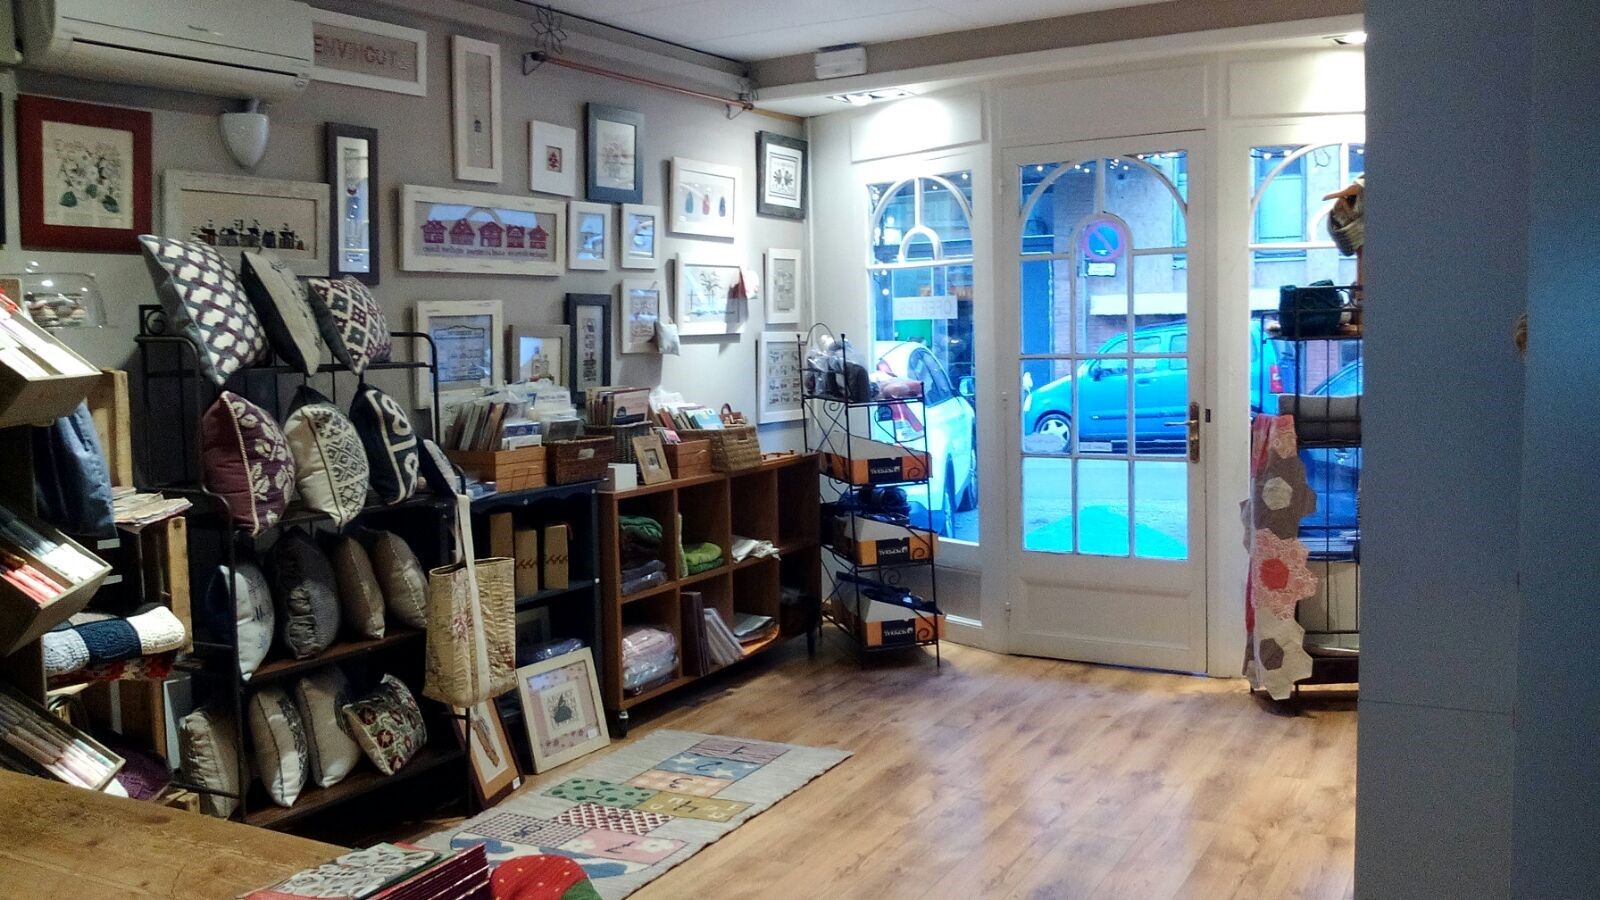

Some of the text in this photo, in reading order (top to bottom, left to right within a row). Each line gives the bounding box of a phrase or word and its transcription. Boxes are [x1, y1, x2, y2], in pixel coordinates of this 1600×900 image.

[696, 761, 723, 771] 2
[669, 777, 694, 788] 3
[673, 801, 699, 813] 4
[604, 841, 636, 853] 7
